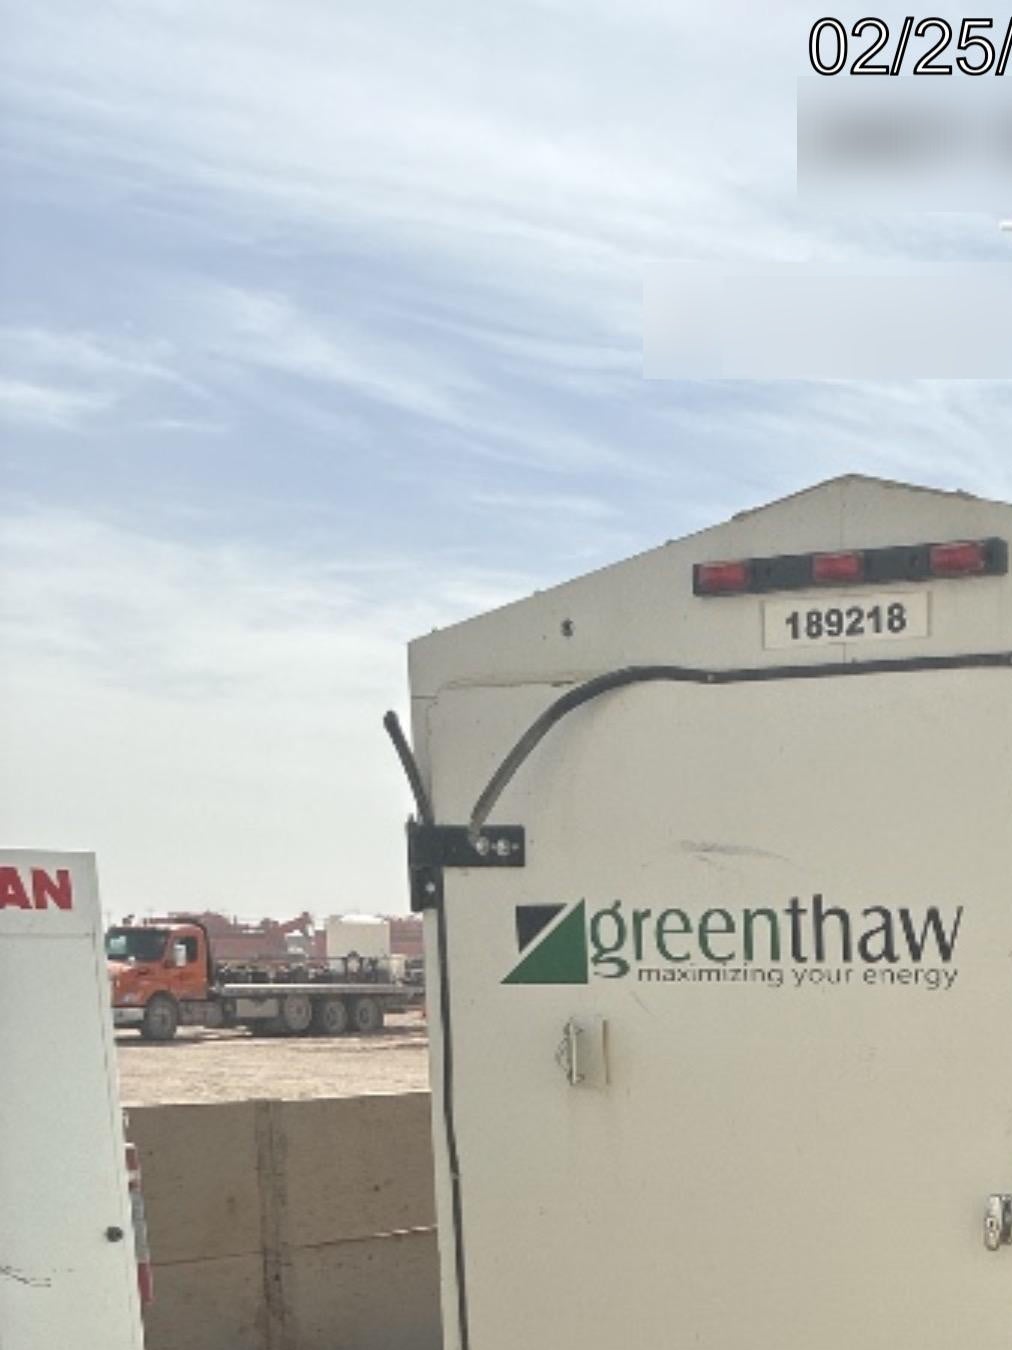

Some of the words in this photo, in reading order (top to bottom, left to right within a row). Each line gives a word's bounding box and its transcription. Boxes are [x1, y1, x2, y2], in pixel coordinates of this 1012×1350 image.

[785, 602, 907, 640] 189218
[0, 866, 73, 910] AN
[590, 894, 964, 978] greenthaw
[637, 962, 784, 987] maximizing
[792, 966, 854, 988] your
[863, 966, 958, 991] energy
